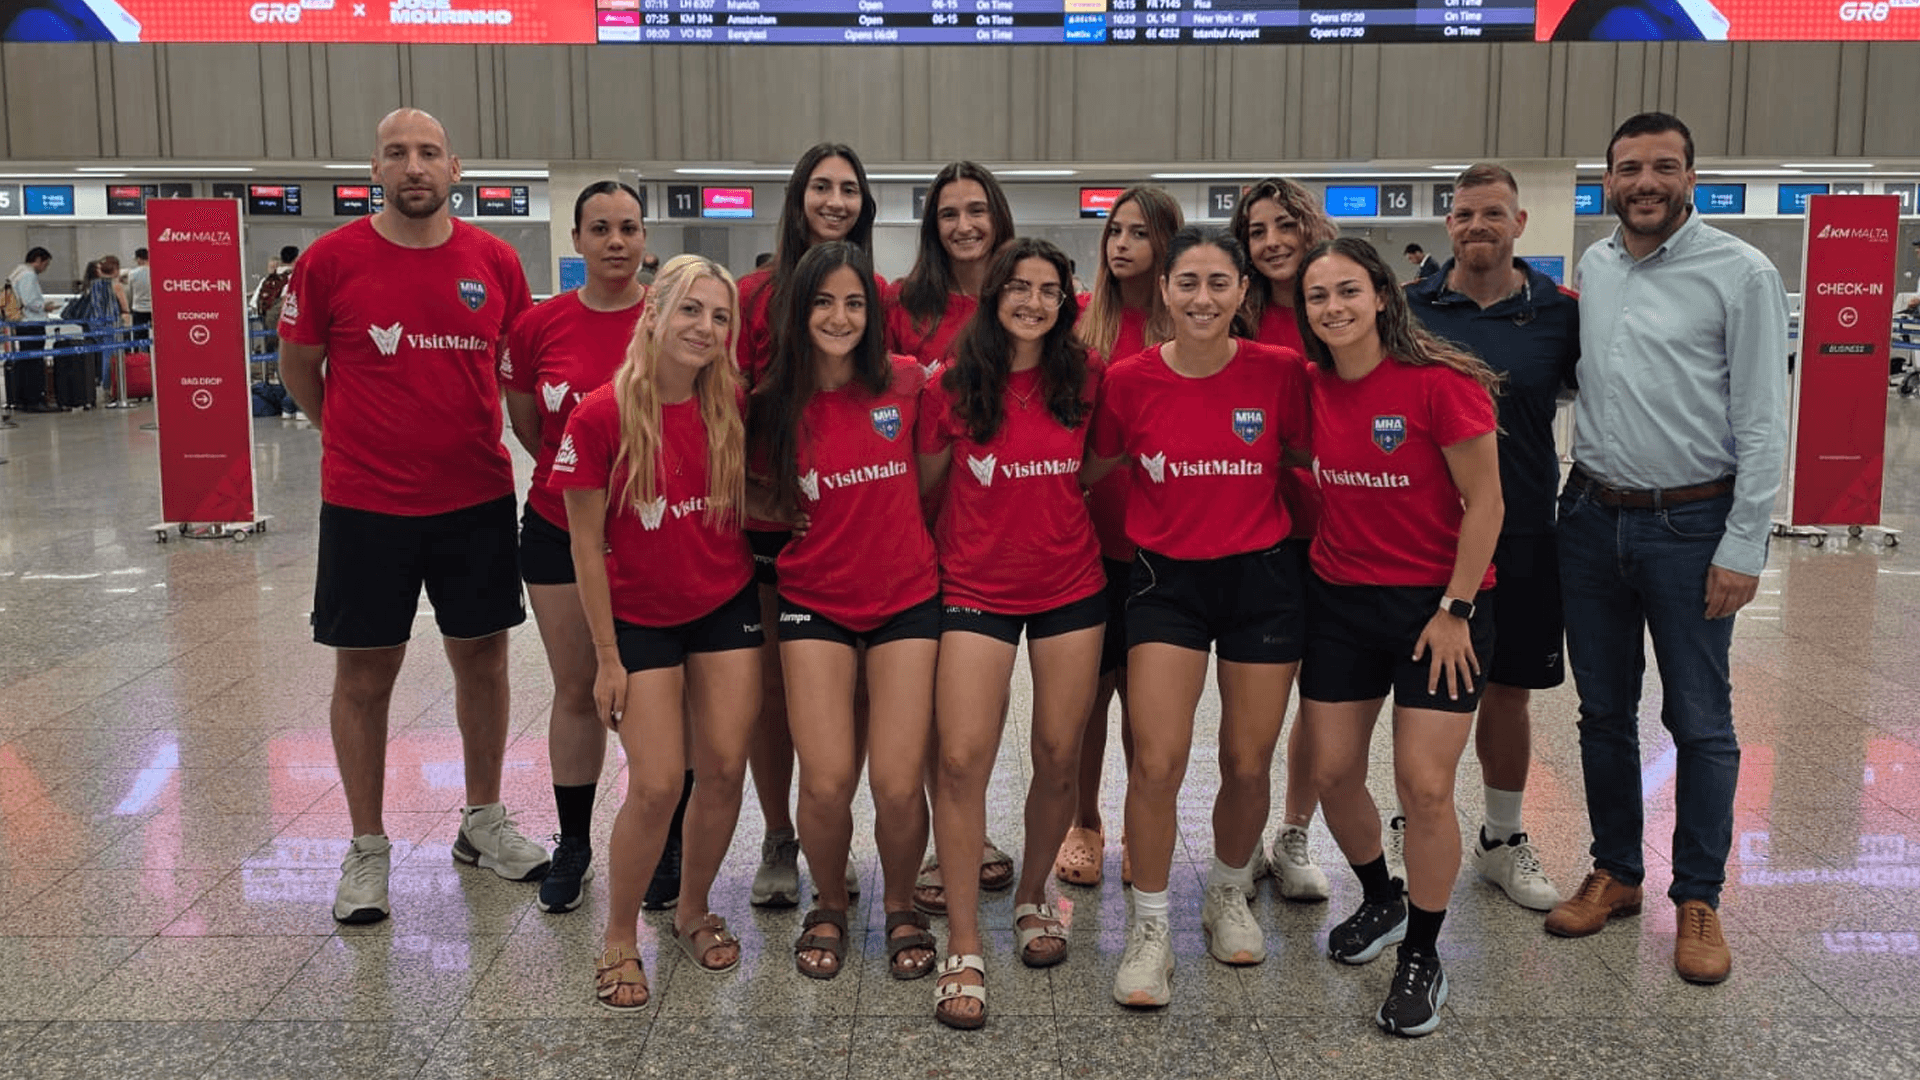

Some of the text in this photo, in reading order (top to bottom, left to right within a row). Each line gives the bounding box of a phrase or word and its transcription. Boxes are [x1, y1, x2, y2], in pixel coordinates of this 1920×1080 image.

[250, 3, 300, 23] GR8
[390, 9, 512, 24] MOURINHO
[1193, 13, 1214, 24] New
[1215, 12, 1234, 24] York
[1310, 12, 1339, 25] Opens
[1445, 11, 1459, 22] On
[1460, 11, 1482, 21] Time
[1839, 1, 1890, 22] GR8
[645, 14, 669, 24] 07:25
[727, 14, 777, 25] Amsterdam
[859, 14, 883, 27] Open
[976, 14, 990, 25] On
[992, 14, 1013, 25] Time
[728, 28, 767, 42] Benghazi
[844, 29, 872, 42] Opens
[976, 29, 990, 40] On
[992, 29, 1013, 40] Time
[1193, 28, 1228, 39] Istanbul
[1228, 28, 1260, 41] Airport
[1310, 27, 1339, 40] Opens
[1444, 26, 1458, 37] On
[1459, 26, 1482, 37] Time
[452, 192, 464, 209] 9
[676, 194, 692, 210] 11
[1215, 194, 1234, 210] 15
[1388, 192, 1407, 209] 16
[171, 231, 231, 242] KM MALTA
[1830, 227, 1888, 238] KM MALTA
[163, 279, 231, 292] CHECK-IN
[1817, 283, 1883, 295] CHECK-IN
[177, 312, 219, 320] ECONOMY
[407, 333, 488, 351] VisitMalta
[200, 377, 223, 386] DROP
[1235, 412, 1263, 422] MHA
[1375, 419, 1403, 430] MHA
[822, 461, 908, 490] VisitMalta
[1169, 458, 1263, 478] VisitMalta
[1322, 469, 1410, 488] VisitMalta
